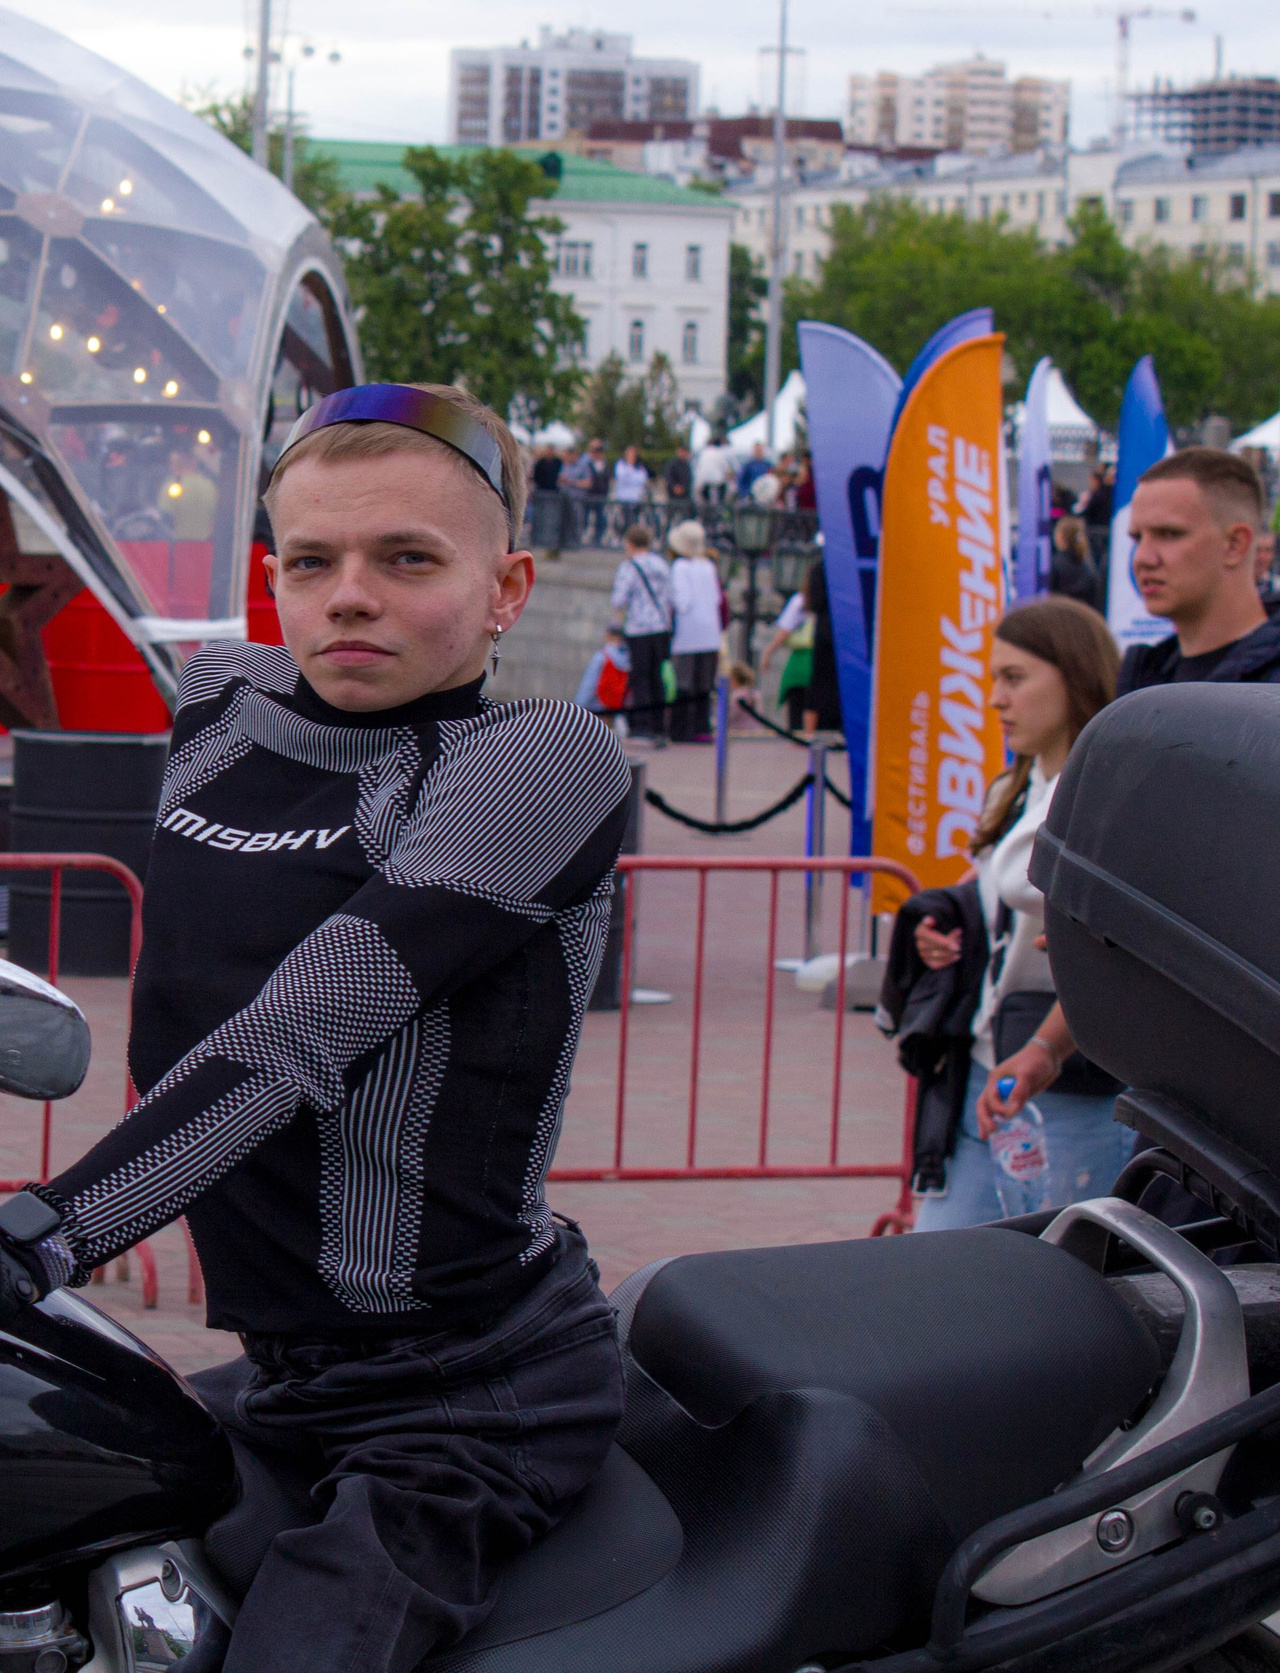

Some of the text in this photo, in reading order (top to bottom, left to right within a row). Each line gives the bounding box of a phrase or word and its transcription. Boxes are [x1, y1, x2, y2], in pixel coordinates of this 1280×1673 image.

[926, 423, 951, 527] УРАЛ
[906, 690, 931, 856] ФЕСТИВАЛЬ
[161, 807, 352, 852] MISBHV
